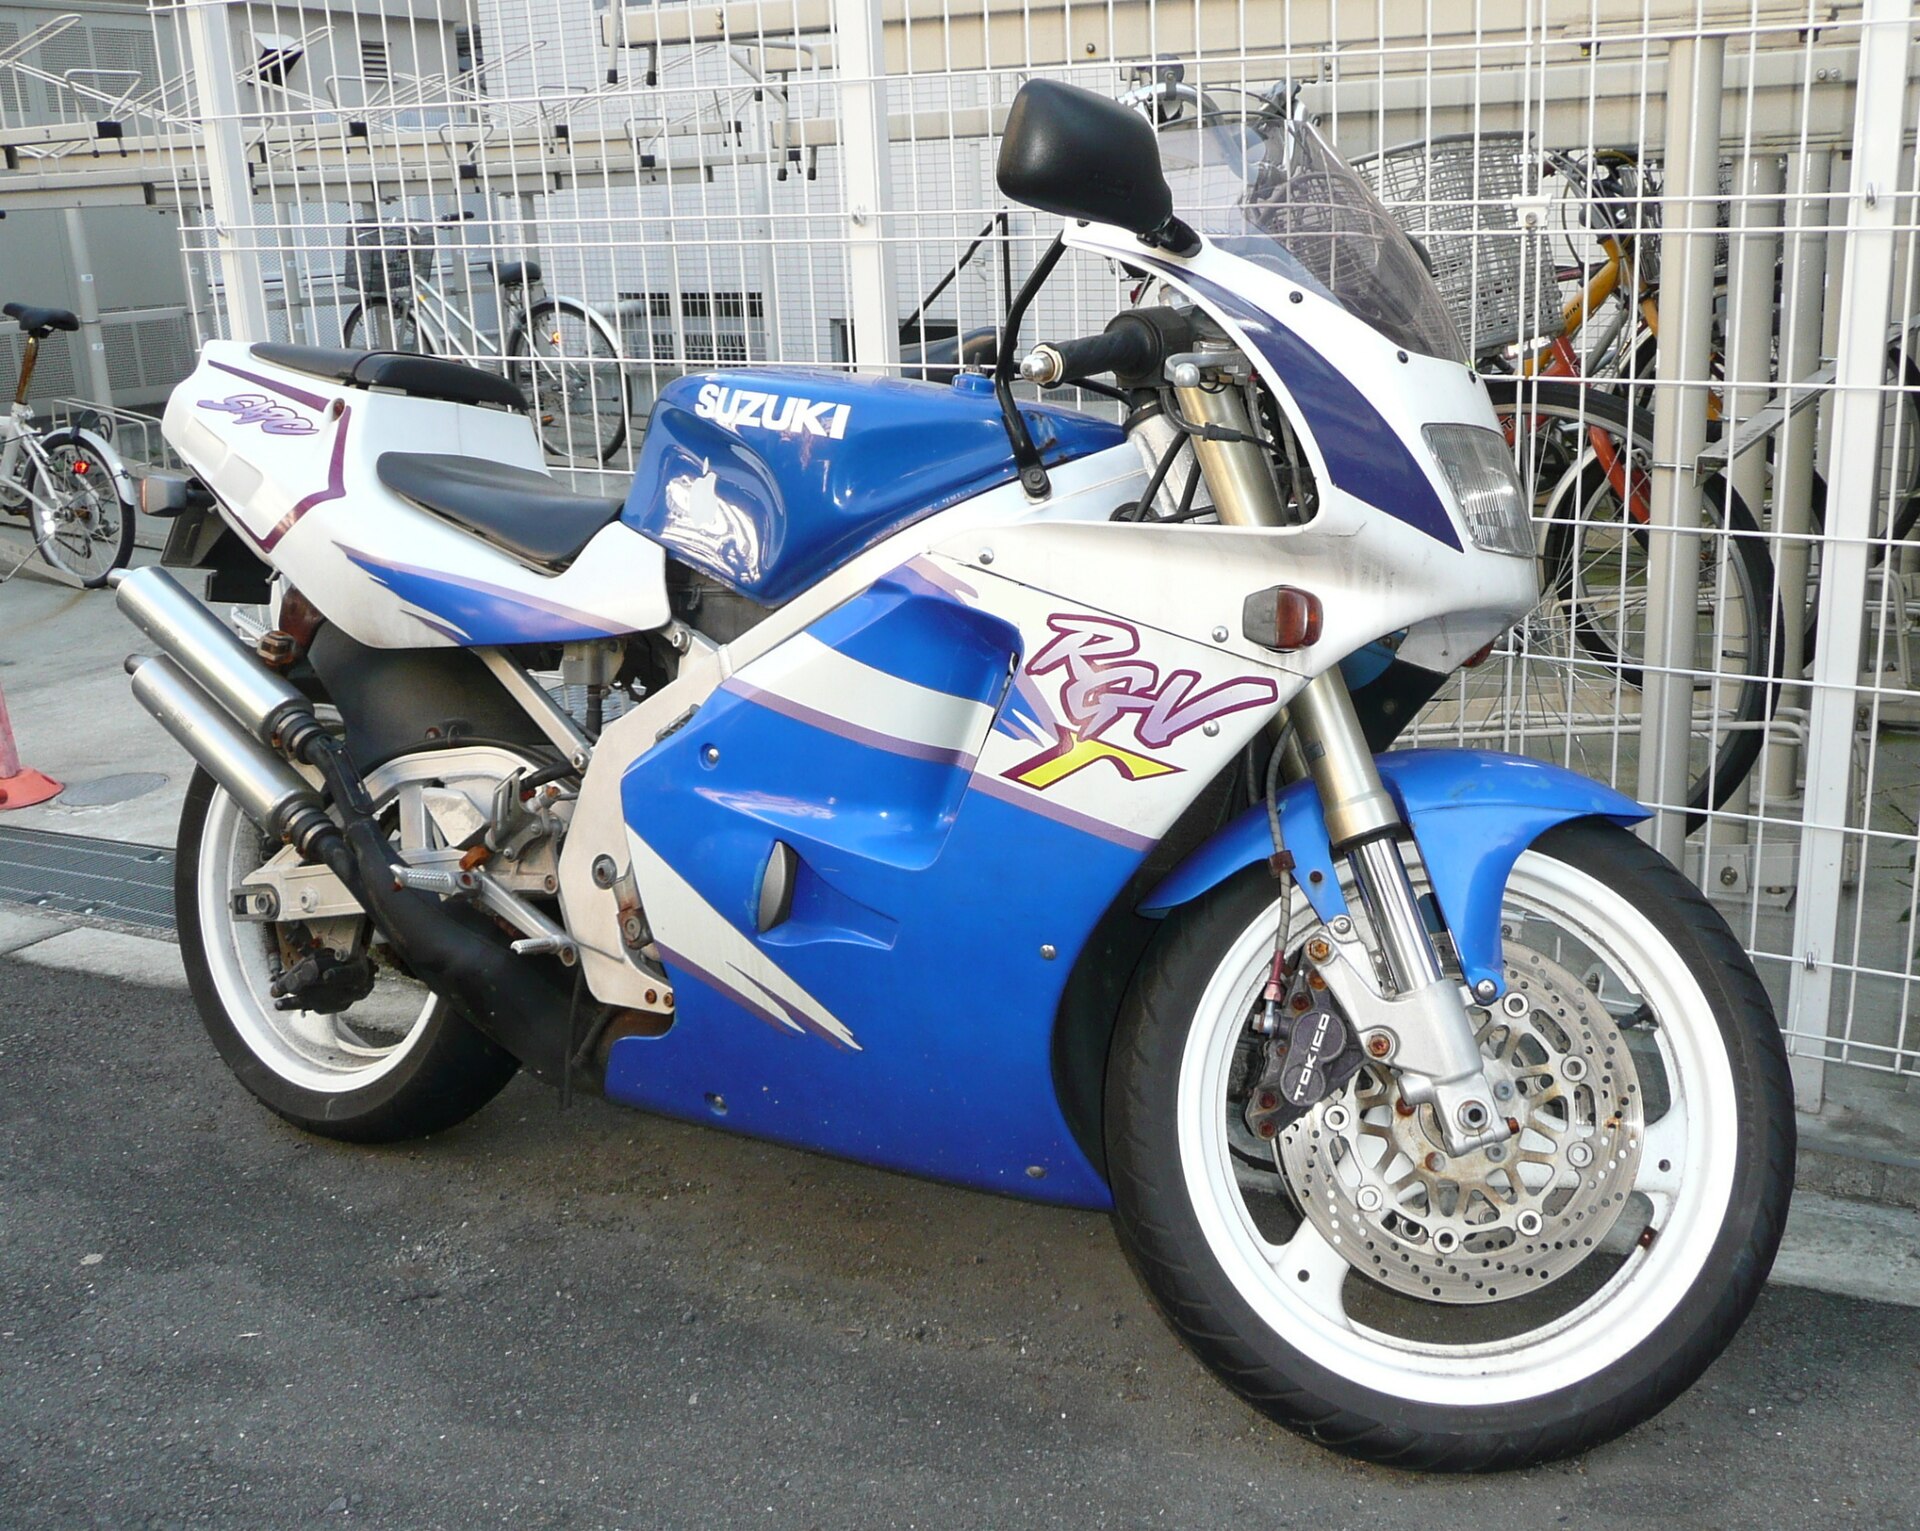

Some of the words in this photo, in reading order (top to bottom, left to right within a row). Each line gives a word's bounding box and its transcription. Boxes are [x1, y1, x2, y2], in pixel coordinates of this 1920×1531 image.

[695, 383, 852, 440] SUZUKI
[1025, 613, 1279, 749] RGV
[1293, 1013, 1331, 1101] TOKICO
